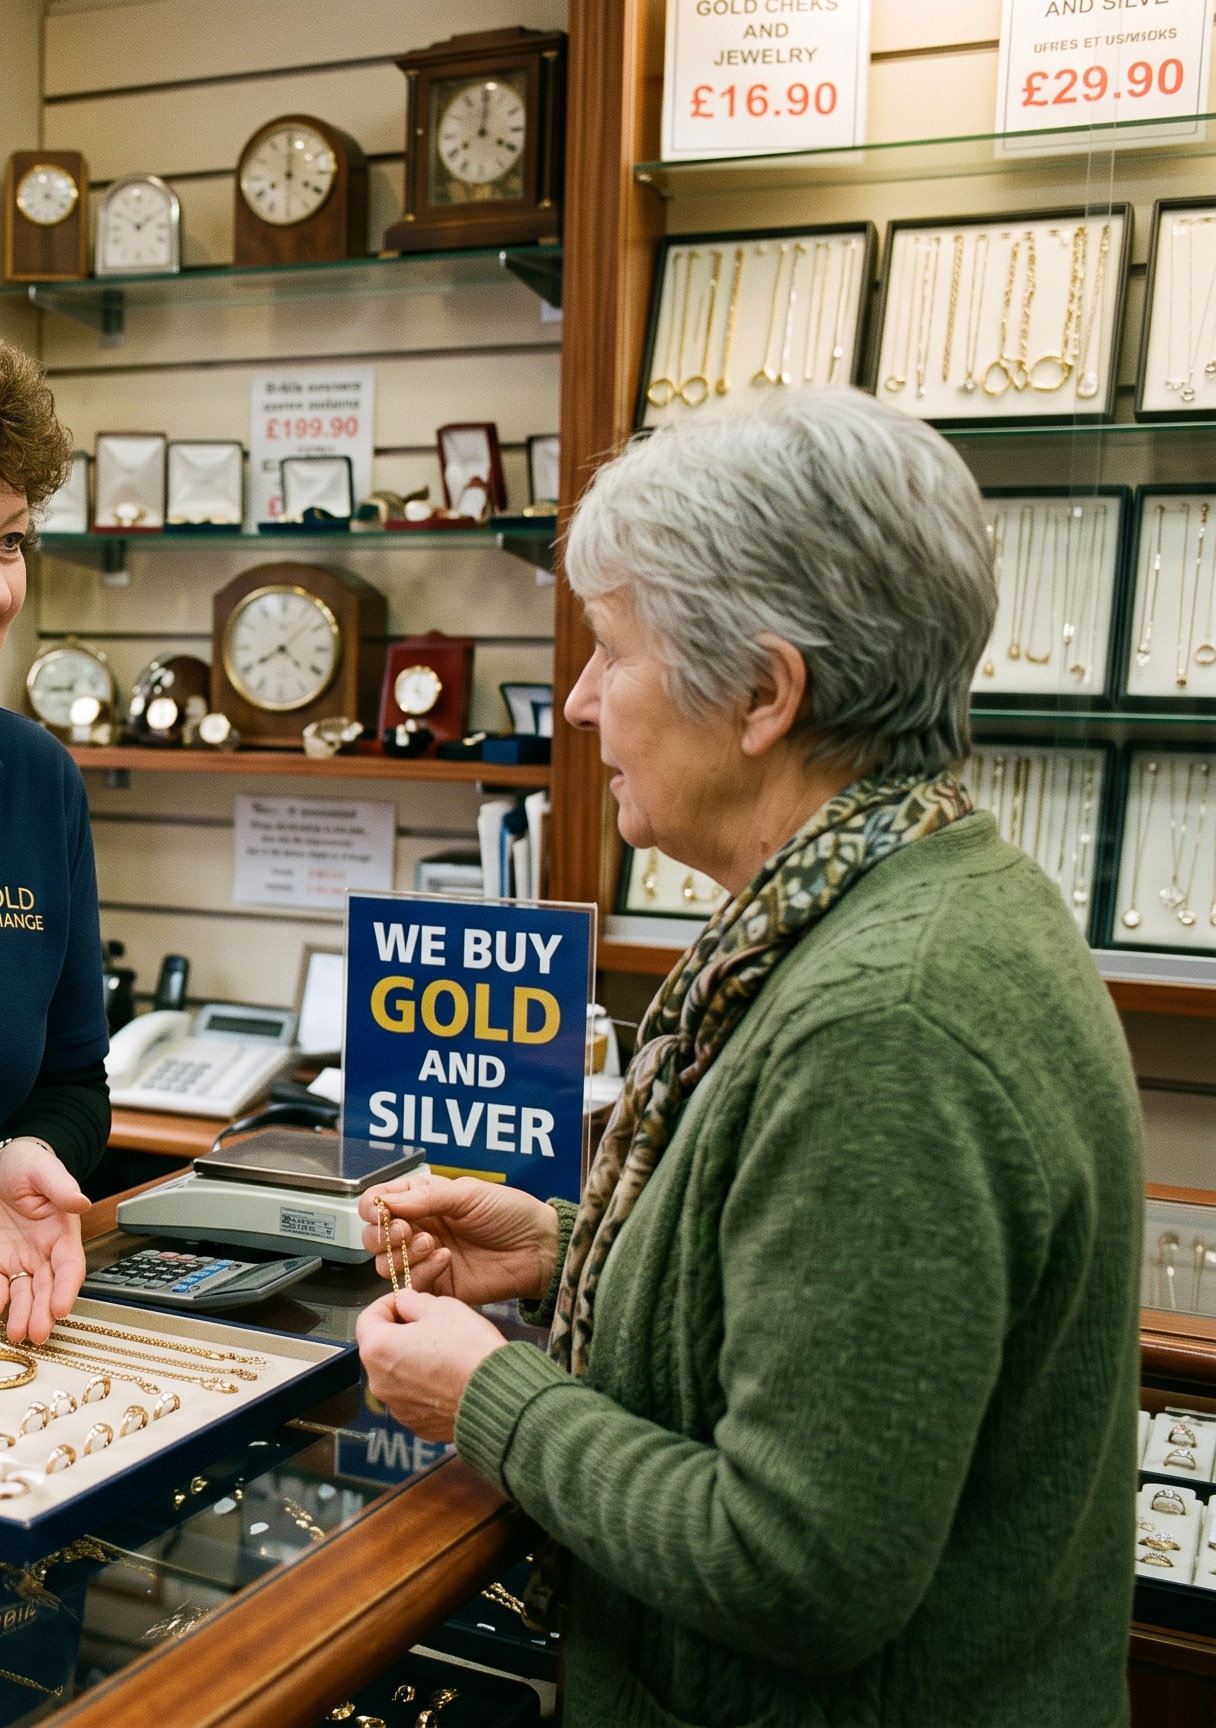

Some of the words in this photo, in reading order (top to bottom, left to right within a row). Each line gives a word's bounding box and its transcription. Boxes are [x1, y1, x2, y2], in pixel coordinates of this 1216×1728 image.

[695, 0, 759, 16] GOLD
[1045, 0, 1094, 17] AND
[742, 23, 789, 39] AND
[713, 47, 818, 66] JEWELRY
[690, 82, 839, 119] £16.90
[1022, 58, 1185, 107] £29.90
[265, 415, 360, 441] £199.90
[373, 922, 446, 966] WE
[463, 928, 563, 974] BUY
[370, 975, 561, 1044] GOLD
[418, 1050, 506, 1088] AND
[369, 1091, 555, 1157] SILVER
